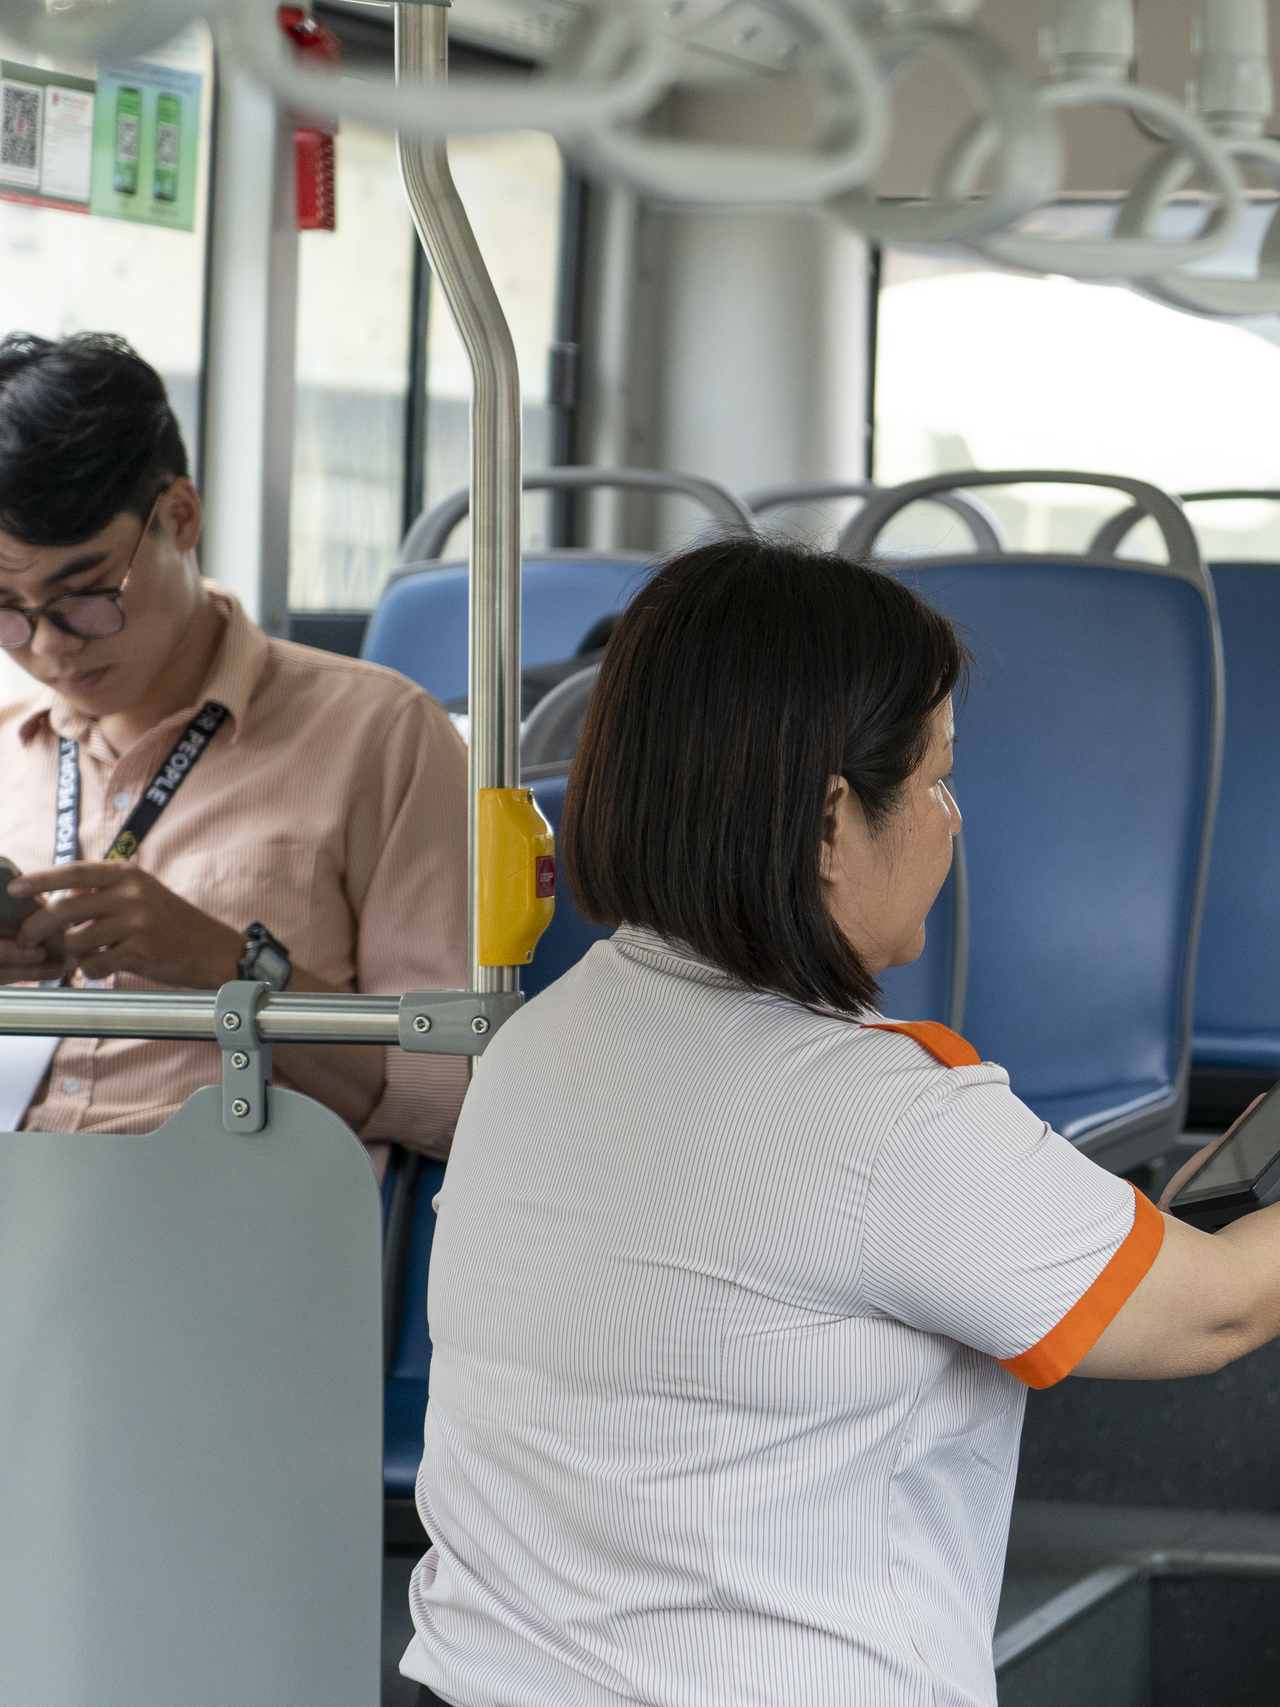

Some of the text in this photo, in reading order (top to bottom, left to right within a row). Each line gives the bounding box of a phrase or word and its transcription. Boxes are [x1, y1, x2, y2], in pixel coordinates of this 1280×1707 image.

[146, 729, 205, 806] PEOPLE
[57, 810, 75, 852] FOR
[540, 872, 553, 882] STOP
